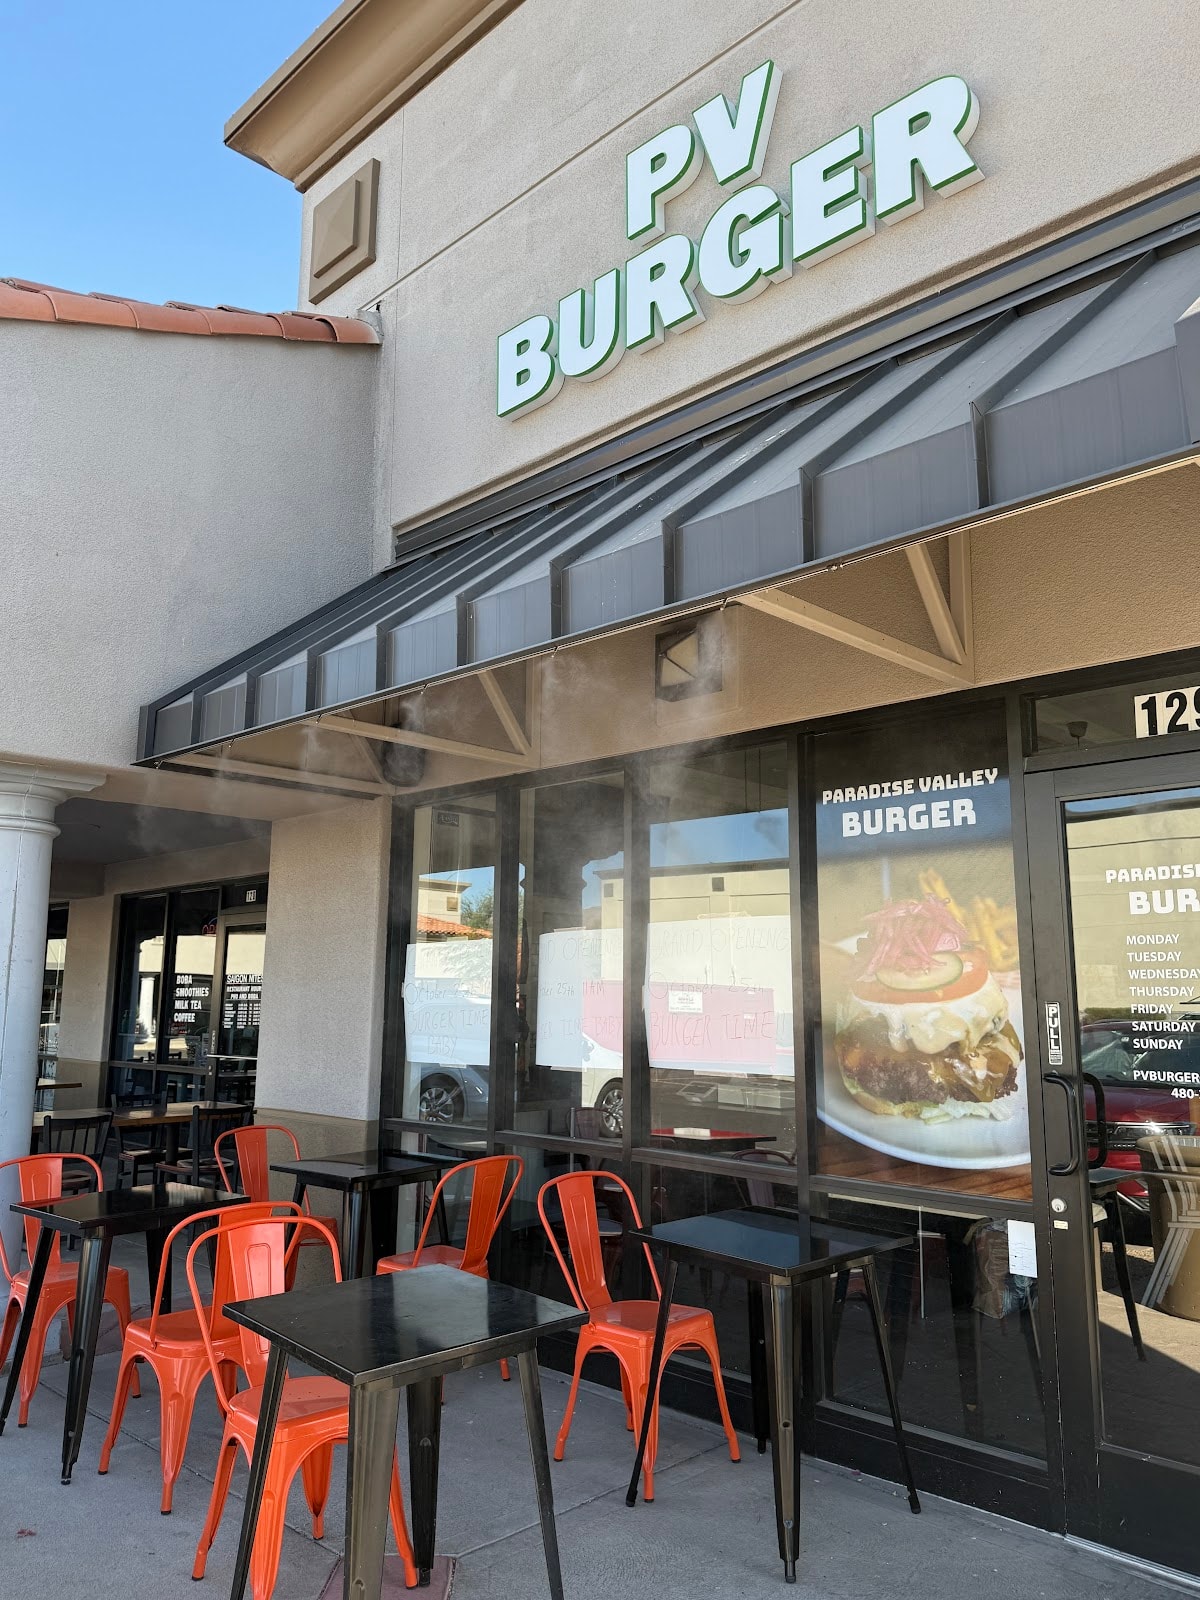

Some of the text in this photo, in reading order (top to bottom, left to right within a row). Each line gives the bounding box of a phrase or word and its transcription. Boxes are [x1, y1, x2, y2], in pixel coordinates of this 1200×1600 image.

[626, 58, 782, 244] PV
[497, 75, 984, 421] BURGER
[1141, 687, 1200, 736] 12
[822, 767, 998, 805] PARADISE VALLEY
[842, 798, 977, 838] BURGER
[1126, 933, 1180, 945] MONDAY
[1126, 951, 1182, 962] TUESDAY
[176, 975, 193, 985] BOBA
[175, 987, 210, 997] SMOOTHIES
[1129, 986, 1195, 997] THURSDAY
[174, 1000, 203, 1010] MILK TEA
[1130, 1003, 1173, 1014] FRIDAY
[173, 1012, 196, 1023] COFFEE
[1048, 1005, 1060, 1050] PULL
[1131, 1021, 1196, 1032] SATURDAY
[1133, 1038, 1184, 1050] SUNDAY
[1170, 1087, 1200, 1100] 480-
